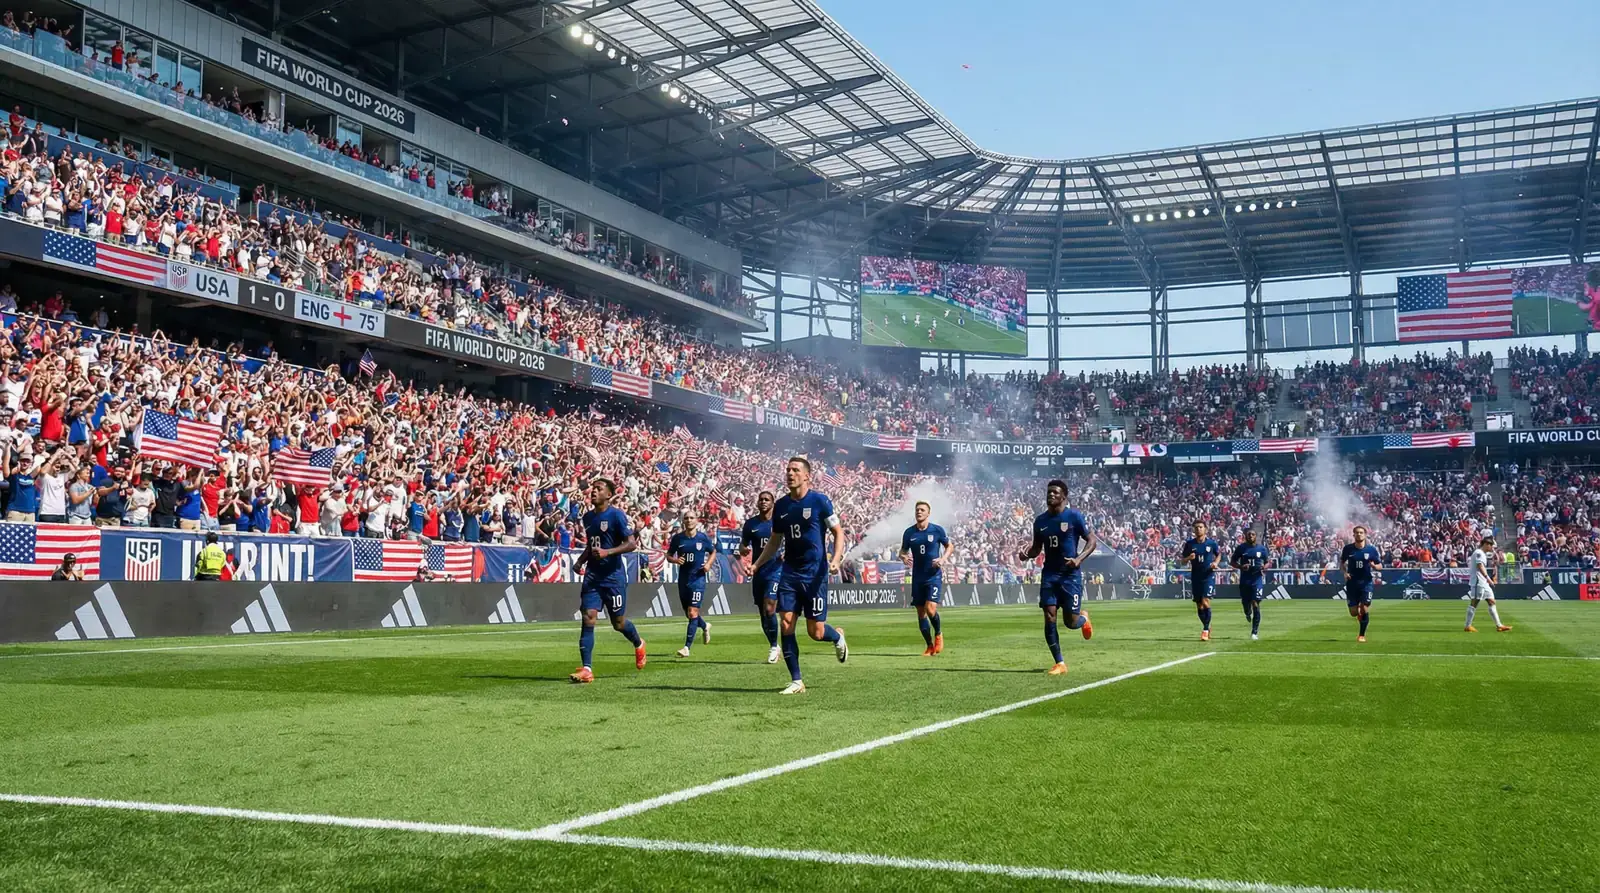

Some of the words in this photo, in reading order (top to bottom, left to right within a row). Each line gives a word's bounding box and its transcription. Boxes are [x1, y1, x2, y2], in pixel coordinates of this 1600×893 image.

[257, 48, 288, 75] FIFA
[292, 63, 342, 97] WORLD
[346, 87, 372, 109] CUP
[374, 100, 405, 125] 2026
[172, 264, 187, 276] USA
[196, 273, 229, 297] USA
[249, 285, 256, 304] 1
[274, 292, 285, 310] 0
[301, 300, 330, 320] ENG
[359, 313, 379, 331] 75'
[425, 328, 450, 349] FIFA
[453, 335, 492, 359] WORLD
[496, 346, 517, 364] CUP
[519, 352, 545, 371] 2026
[766, 412, 779, 426] FIFA
[780, 414, 799, 430] WORLD
[800, 418, 811, 433] CUP
[811, 422, 825, 437] 2026
[1508, 432, 1535, 444] FIFA
[1537, 430, 1584, 443] WORLD
[951, 442, 972, 453] FIFA
[974, 443, 1010, 454] WORLD
[1013, 444, 1034, 455] CUP
[1036, 445, 1064, 456] 2026
[790, 524, 801, 539] 13
[1049, 535, 1059, 548] 13
[128, 540, 159, 563] USA
[920, 544, 926, 555] 8
[612, 595, 622, 608] 10
[827, 590, 838, 604] IFA
[839, 589, 865, 604] WORLD
[866, 590, 878, 604] CUP
[1073, 594, 1079, 606] 9
[812, 597, 824, 611] 10
